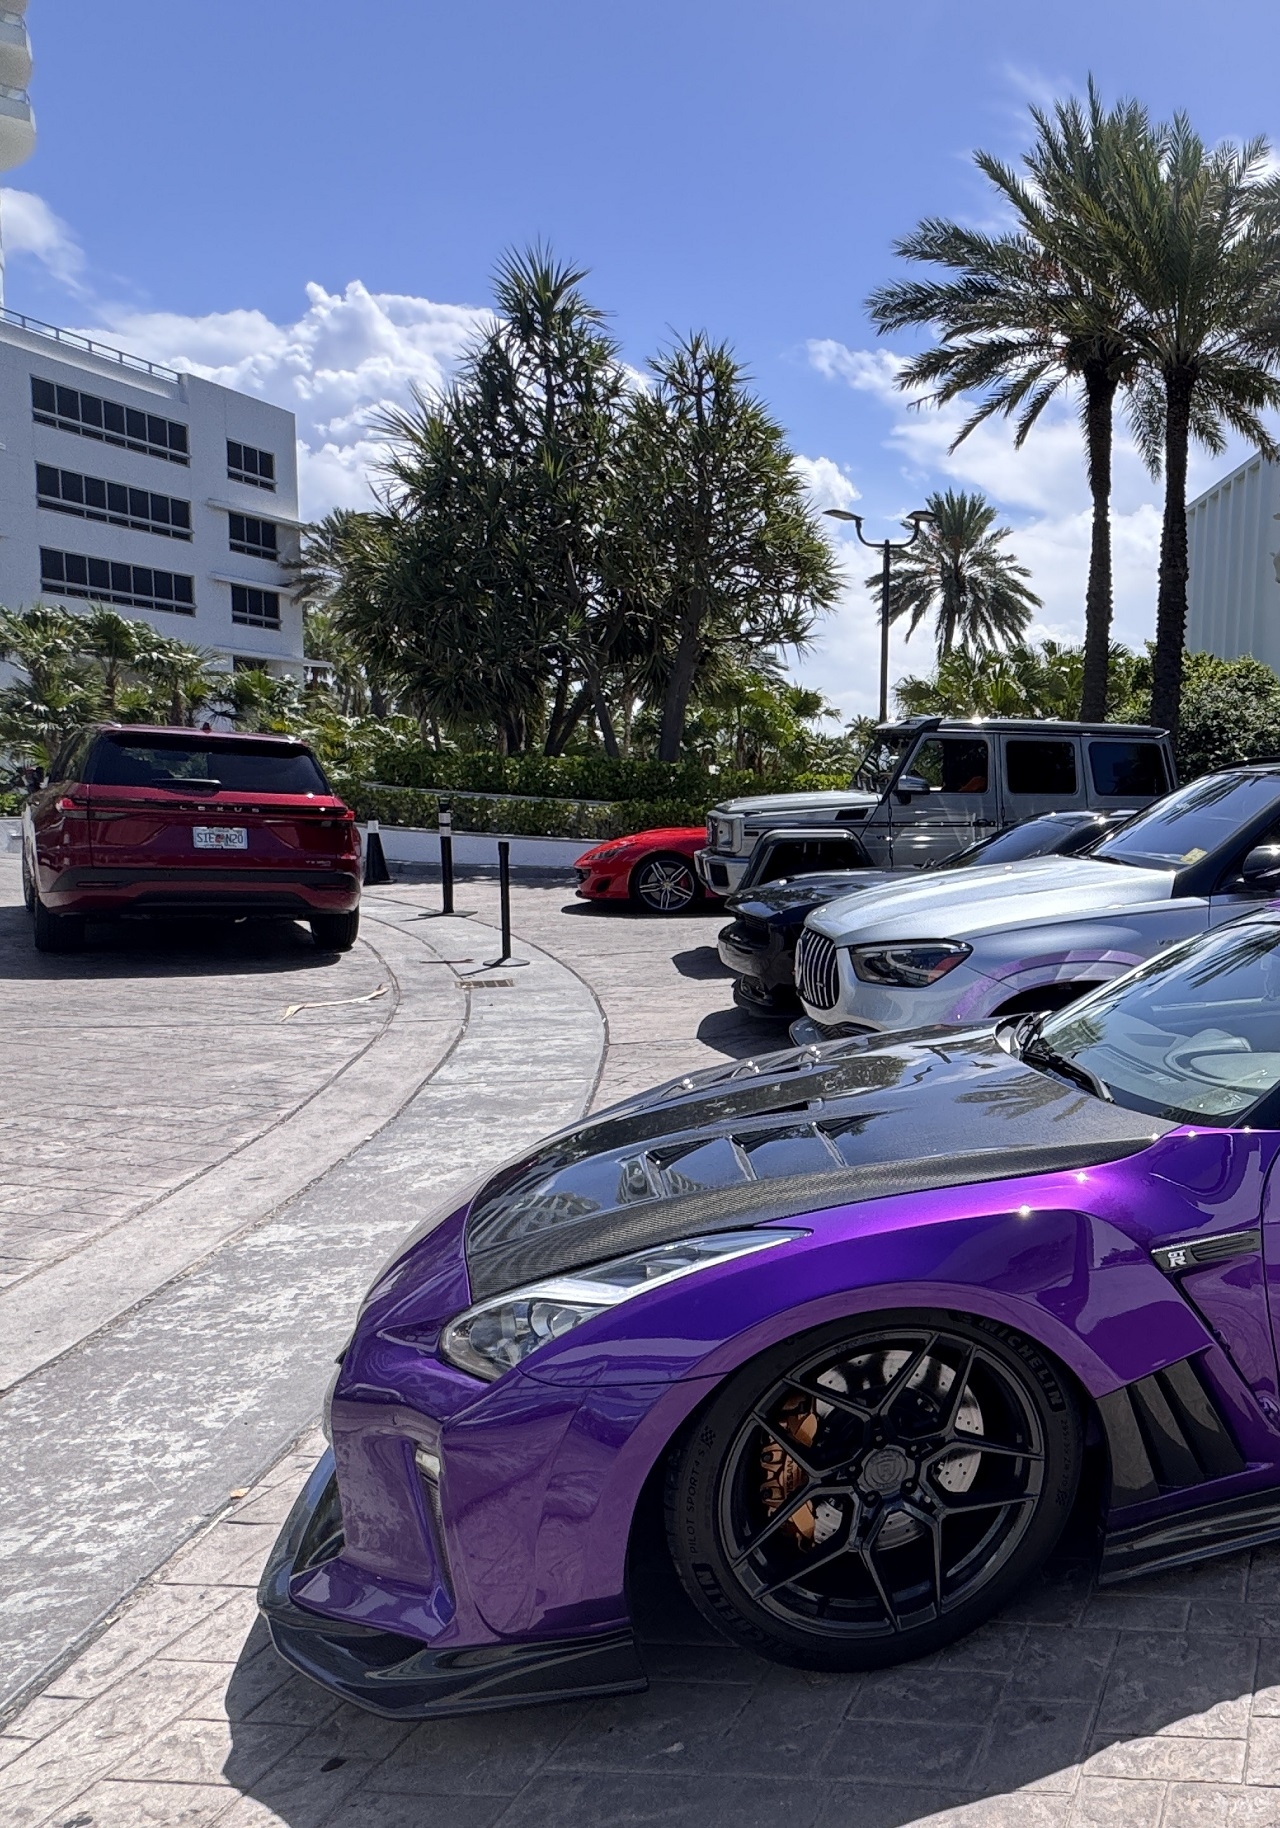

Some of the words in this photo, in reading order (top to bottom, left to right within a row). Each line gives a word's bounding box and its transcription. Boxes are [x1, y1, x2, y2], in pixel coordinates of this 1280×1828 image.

[179, 804, 260, 813] LEXUS
[978, 1319, 1064, 1406] MICHELIN
[686, 1468, 699, 1513] SPORT
[686, 1517, 698, 1554] PILOT
